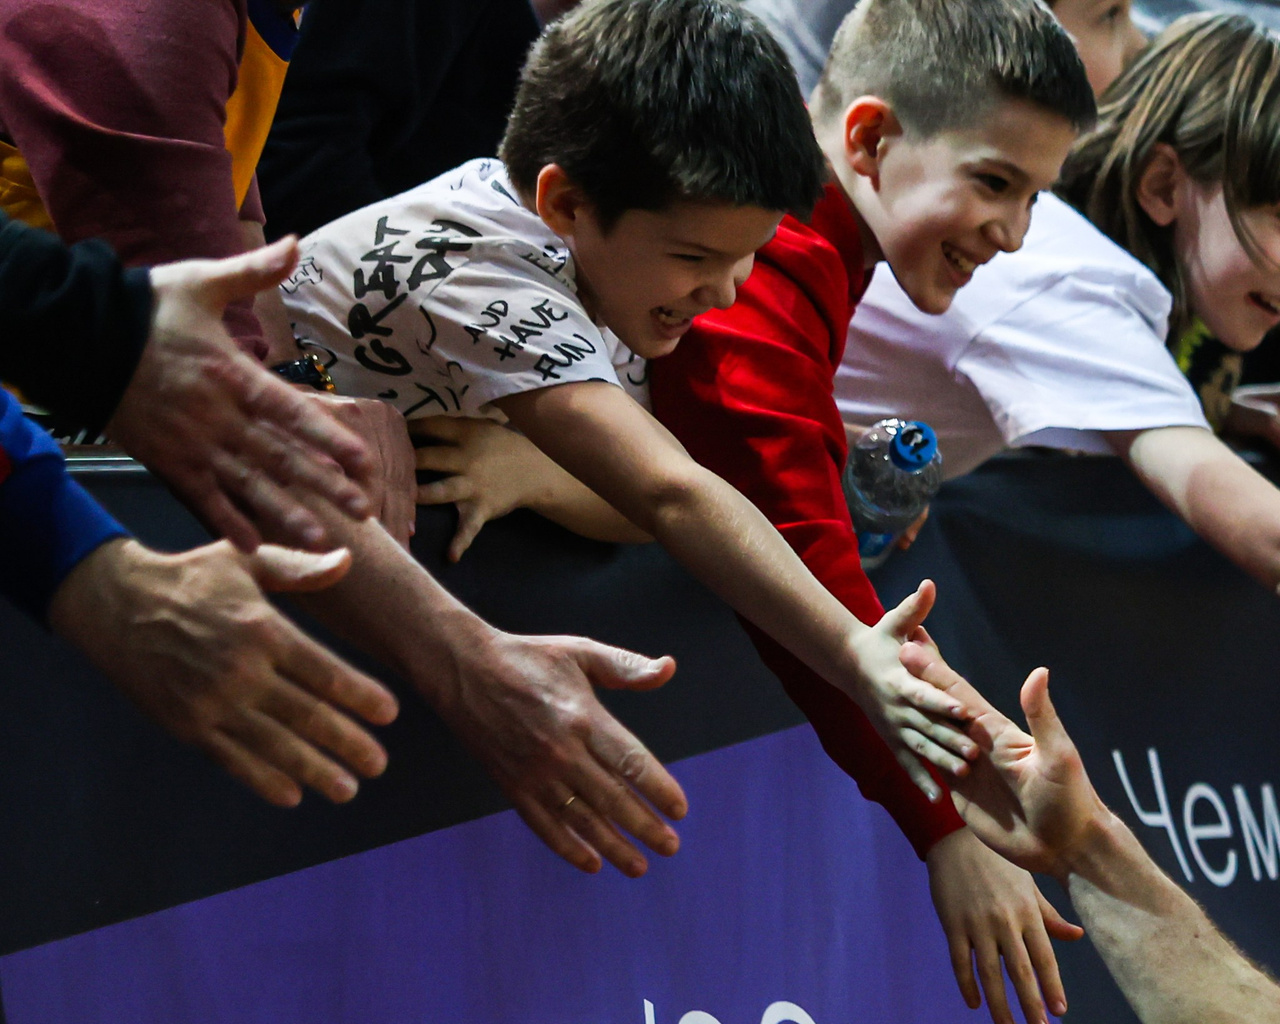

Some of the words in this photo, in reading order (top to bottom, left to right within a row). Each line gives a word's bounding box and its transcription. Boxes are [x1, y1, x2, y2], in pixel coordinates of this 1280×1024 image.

[406, 219, 483, 290] DAY
[348, 215, 413, 376] GREAT
[463, 300, 509, 344] AND
[493, 298, 569, 361] HAVE
[533, 333, 597, 381] FUN
